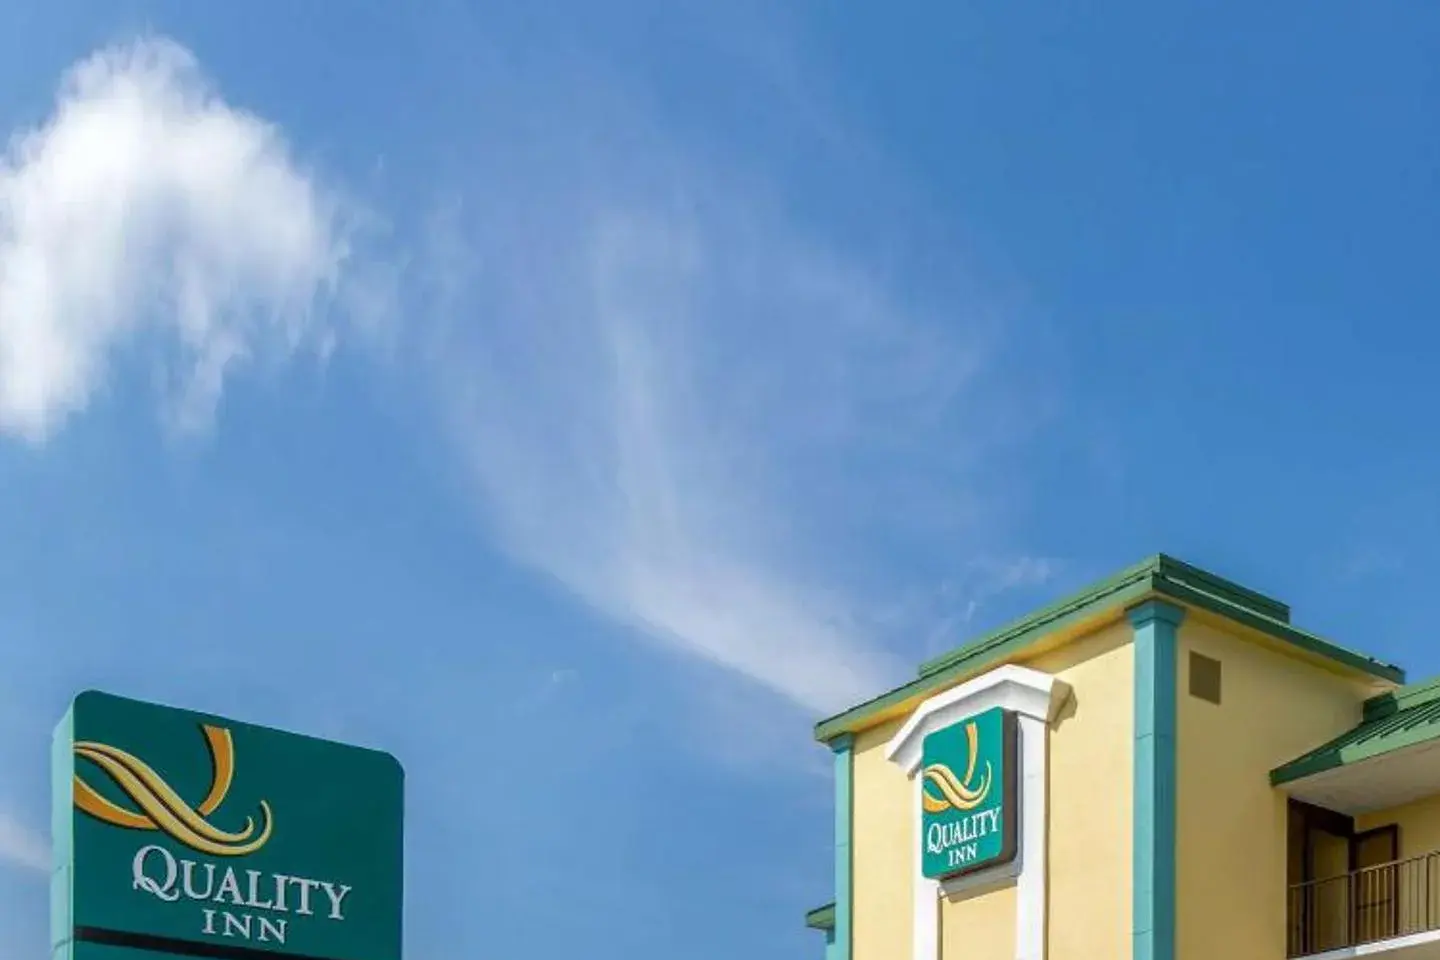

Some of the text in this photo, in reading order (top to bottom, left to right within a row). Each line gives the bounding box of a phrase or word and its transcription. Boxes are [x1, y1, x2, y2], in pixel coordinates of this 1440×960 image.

[927, 807, 1001, 854] QUALITY
[949, 843, 978, 867] INN
[133, 844, 351, 920] QUALITY
[202, 909, 288, 944] INN
